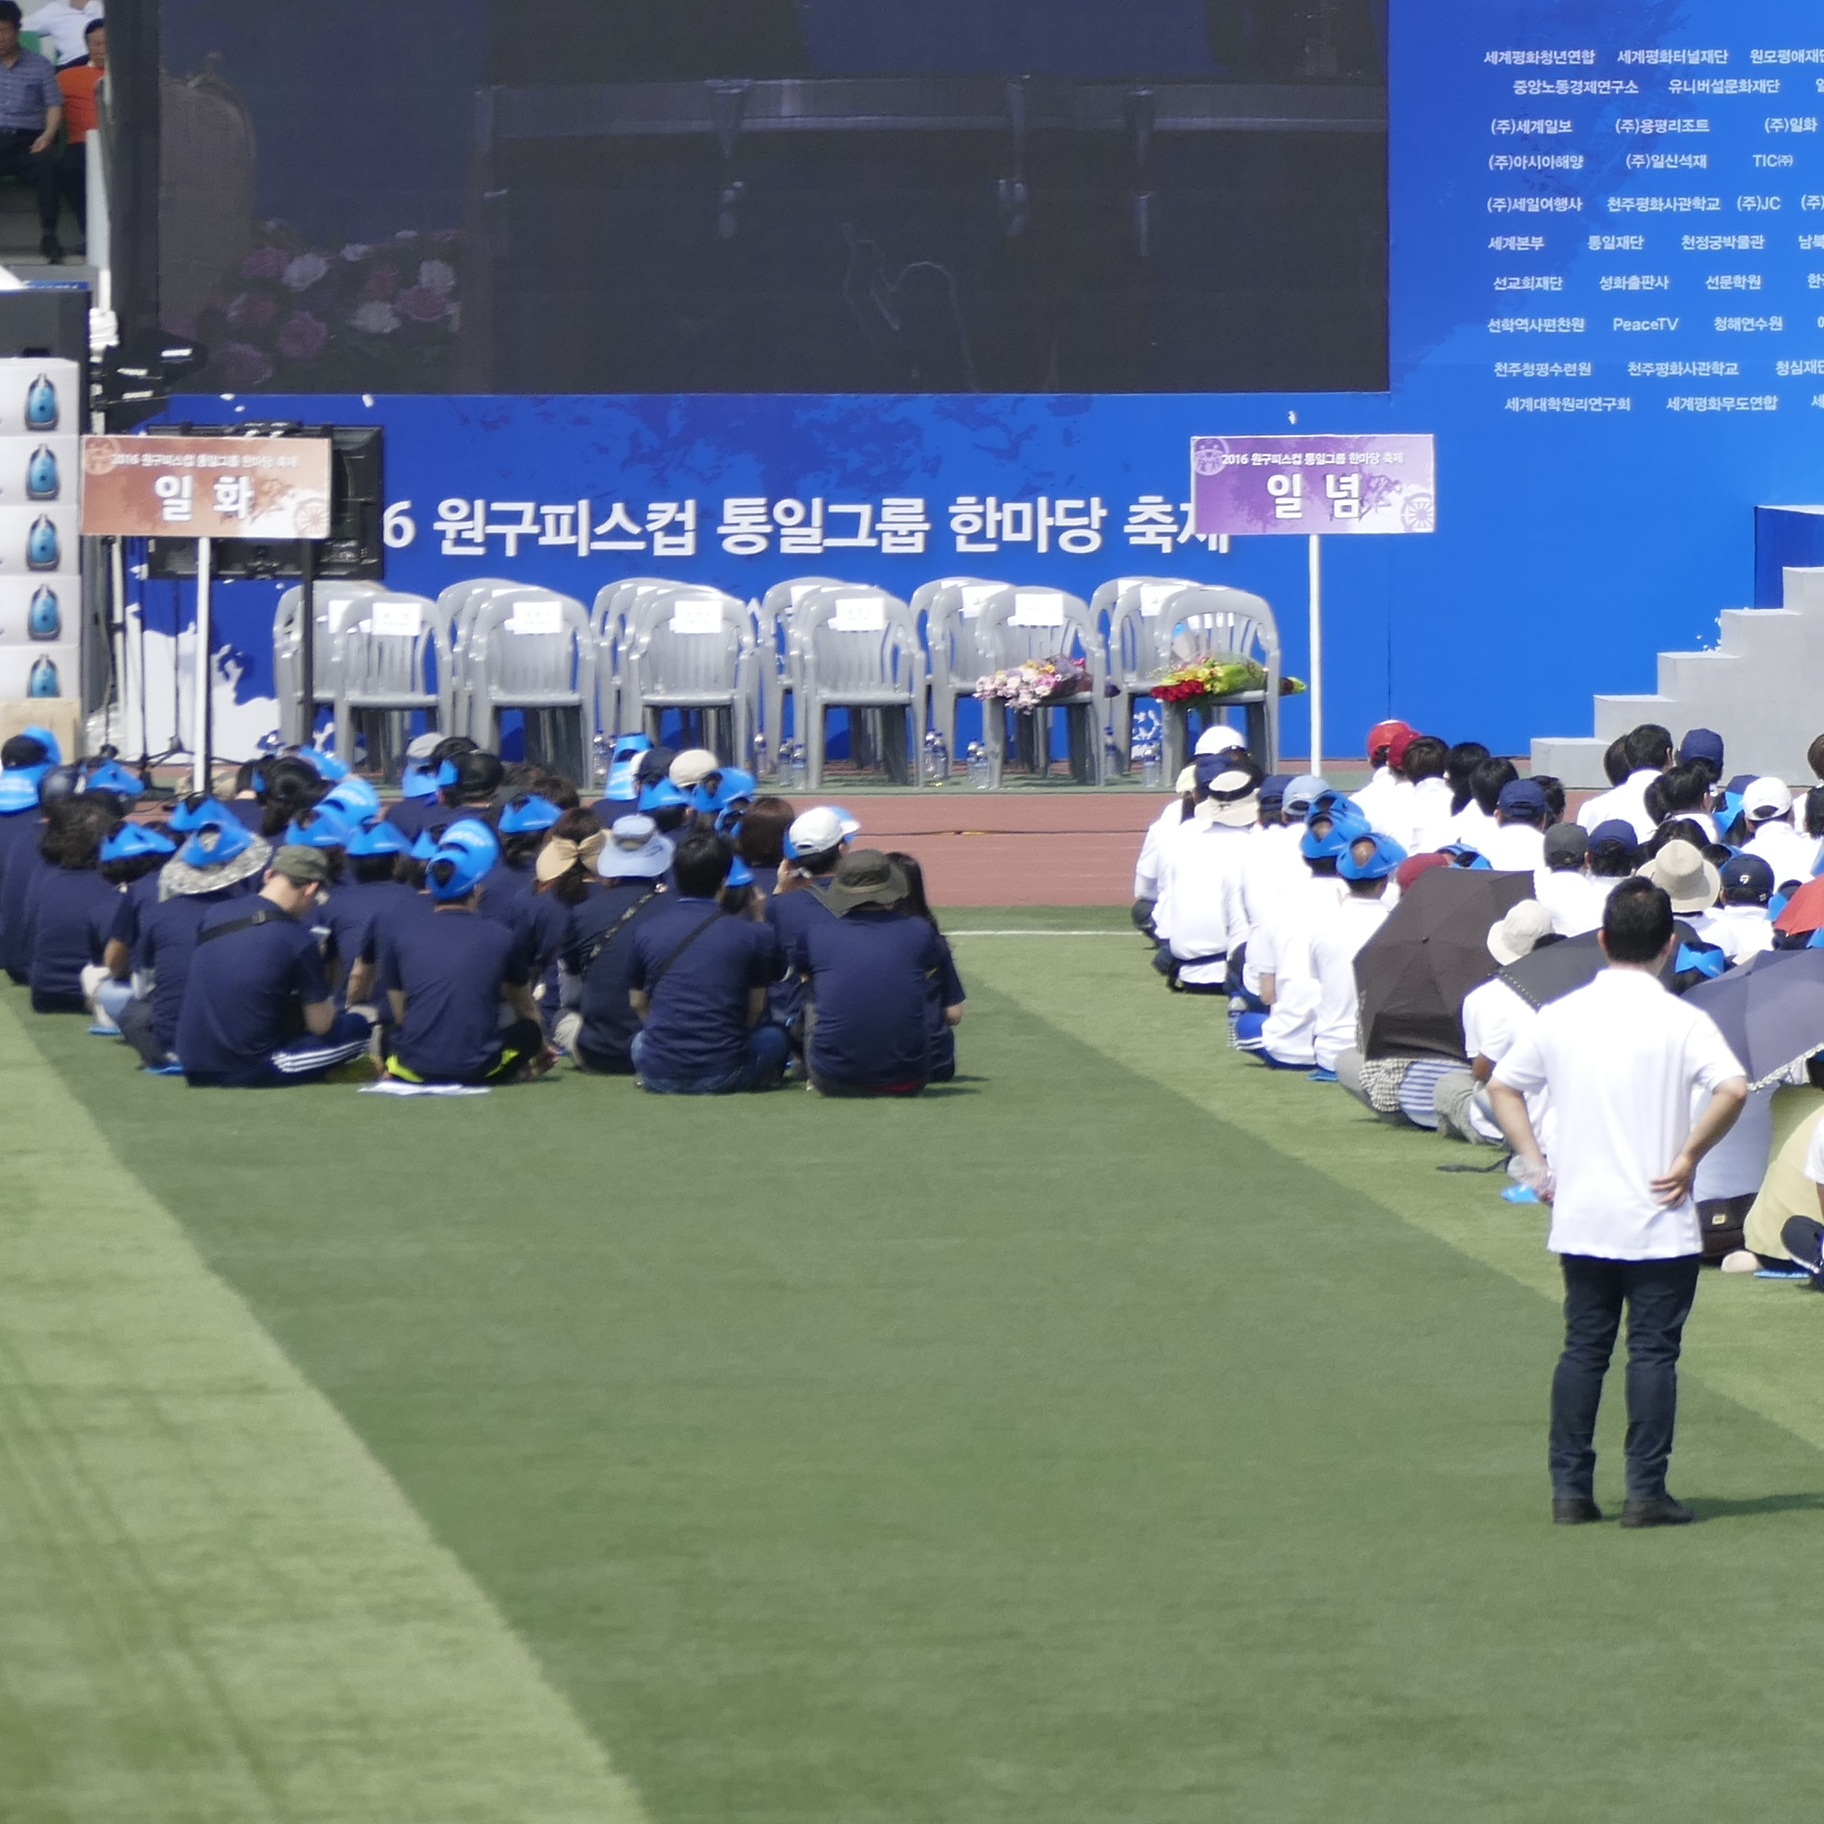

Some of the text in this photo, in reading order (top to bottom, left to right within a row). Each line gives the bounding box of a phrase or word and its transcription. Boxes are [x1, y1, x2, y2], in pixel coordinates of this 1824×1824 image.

[1484, 50, 1596, 65] 세계평화청년연합
[1617, 49, 1728, 64] 세계평화터널재단
[1512, 80, 1639, 95] 중앙노동경제연구소
[1668, 79, 1779, 94] 유니버설문화재단
[1490, 118, 1573, 135] (주)세계일보
[1615, 118, 1710, 134] (주)용평리조트
[1764, 117, 1818, 133] (주)일화
[1488, 154, 1584, 170] (주)아시아해양
[1626, 154, 1707, 170] (주)일신석재
[1487, 196, 1582, 213] (주)세일여행사
[1607, 196, 1721, 212] 천주평화사관학교
[1737, 196, 1781, 211] (주)JC
[1487, 236, 1545, 251] 세계본부
[1588, 235, 1644, 251] 통일재단
[1681, 234, 1765, 250] 천정궁박물관
[1493, 276, 1563, 292] 선교회재단
[1599, 275, 1669, 291] 성화출판사
[1706, 275, 1761, 290] 선문학원
[1613, 317, 1679, 331] PeaceTV
[1714, 316, 1783, 332] 청해연수원
[1494, 362, 1592, 377] 천주청평수련원
[1627, 361, 1739, 377] 천주평화사관학교
[1504, 397, 1631, 412] 세계대학원리연구회
[1666, 395, 1778, 412] 세계평화무도연합
[433, 497, 697, 557] 원구피스컵
[716, 496, 932, 555] 통일그룹
[948, 495, 1108, 554] 한마당
